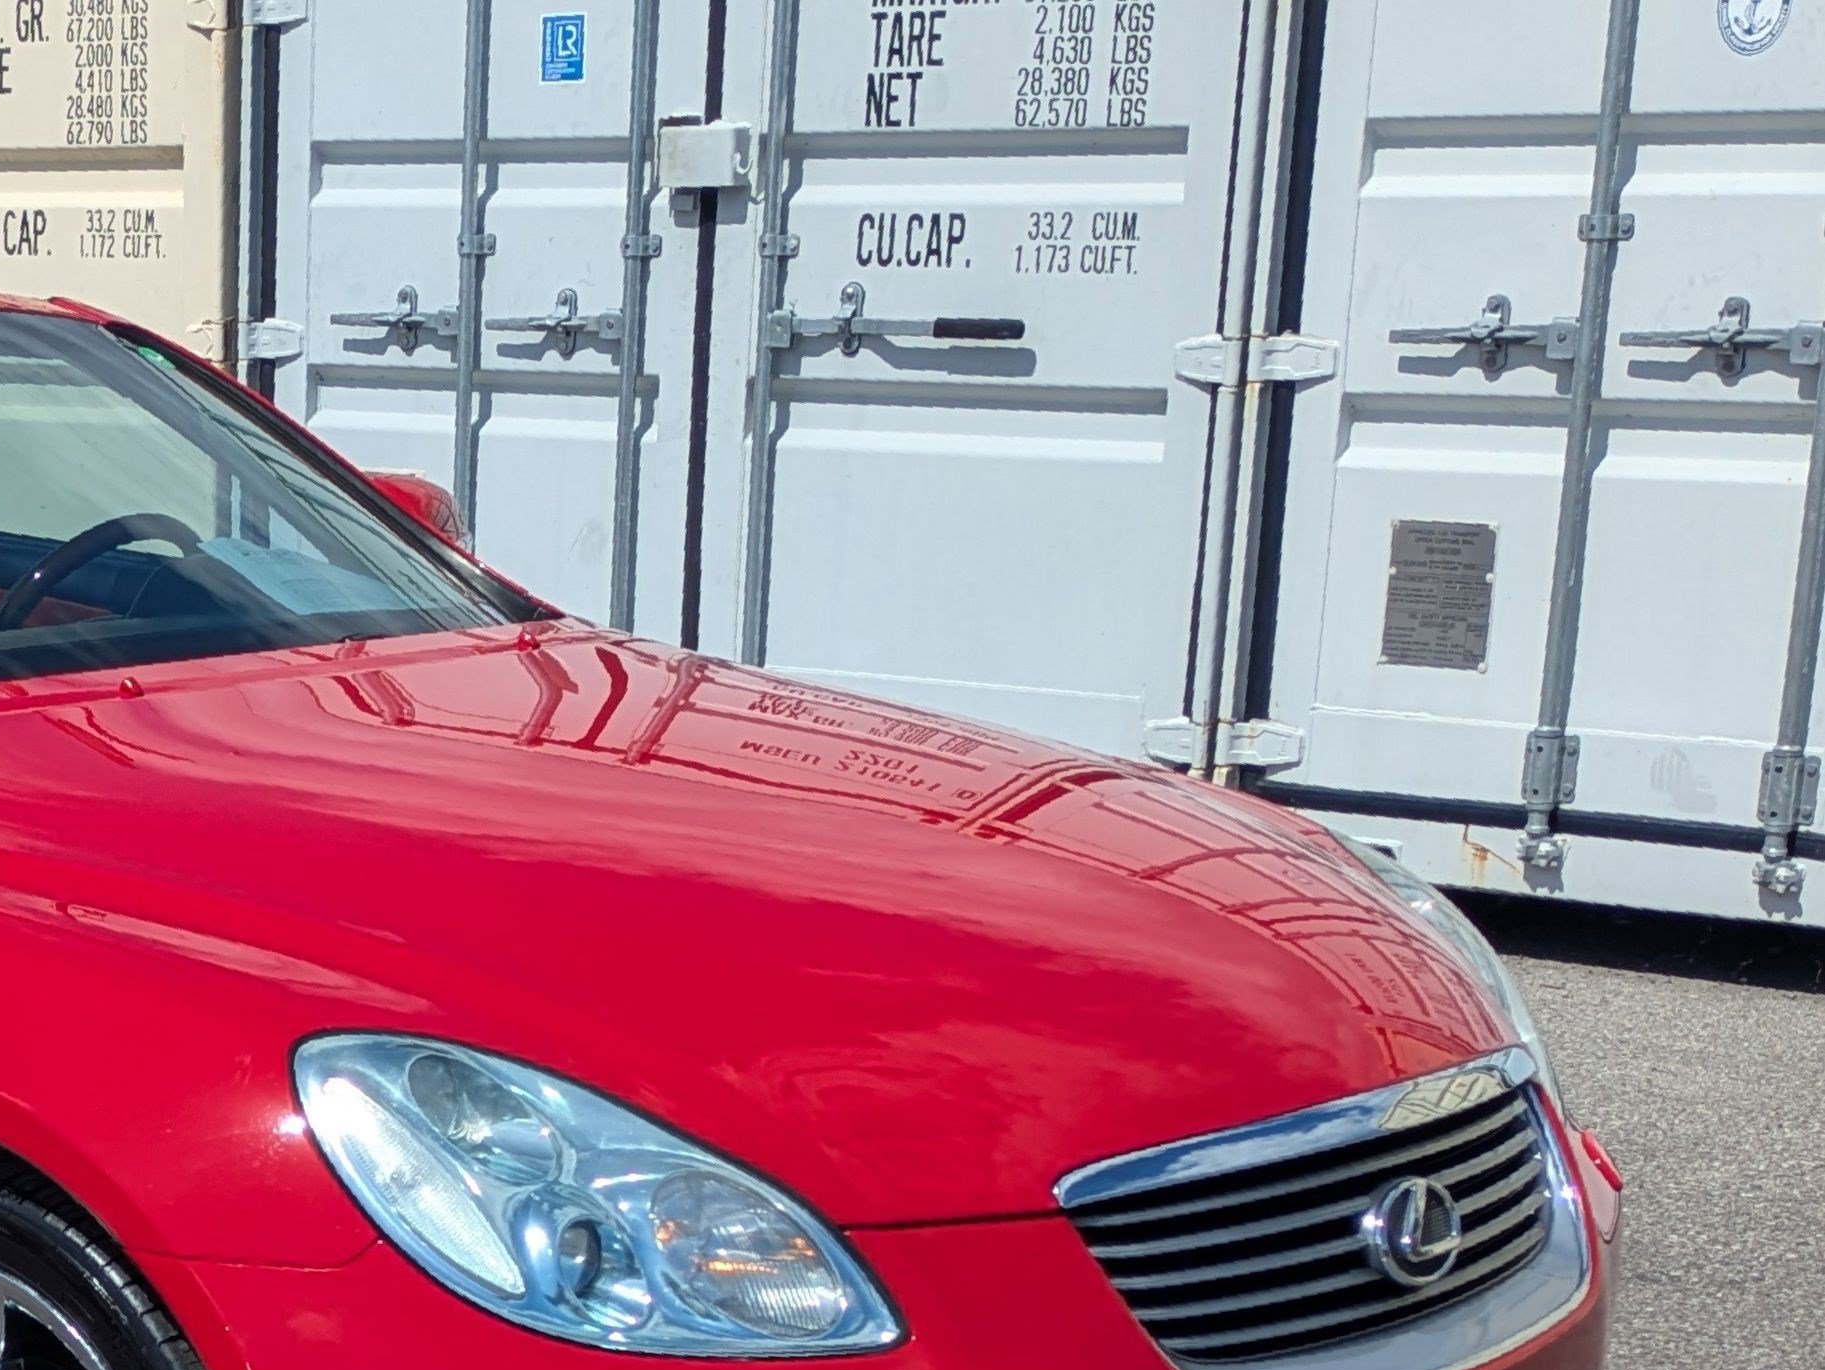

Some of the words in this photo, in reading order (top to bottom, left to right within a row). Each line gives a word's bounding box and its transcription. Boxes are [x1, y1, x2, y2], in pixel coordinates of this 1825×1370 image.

[16, 0, 50, 42] GR.
[120, 16, 149, 41] LBS
[870, 10, 947, 67] TARE
[1113, 2, 1156, 33] KGS
[120, 41, 149, 66] KGS
[1111, 34, 1153, 64] LBS
[120, 67, 149, 93] LBS
[120, 93, 149, 118] KGS
[864, 71, 924, 128] NET
[1109, 65, 1150, 96] KGS
[1106, 97, 1148, 127] LBS
[120, 119, 149, 145] LBS
[3, 209, 53, 256] CAP.
[85, 208, 116, 233] 33.2
[1027, 211, 1074, 241] 33.2
